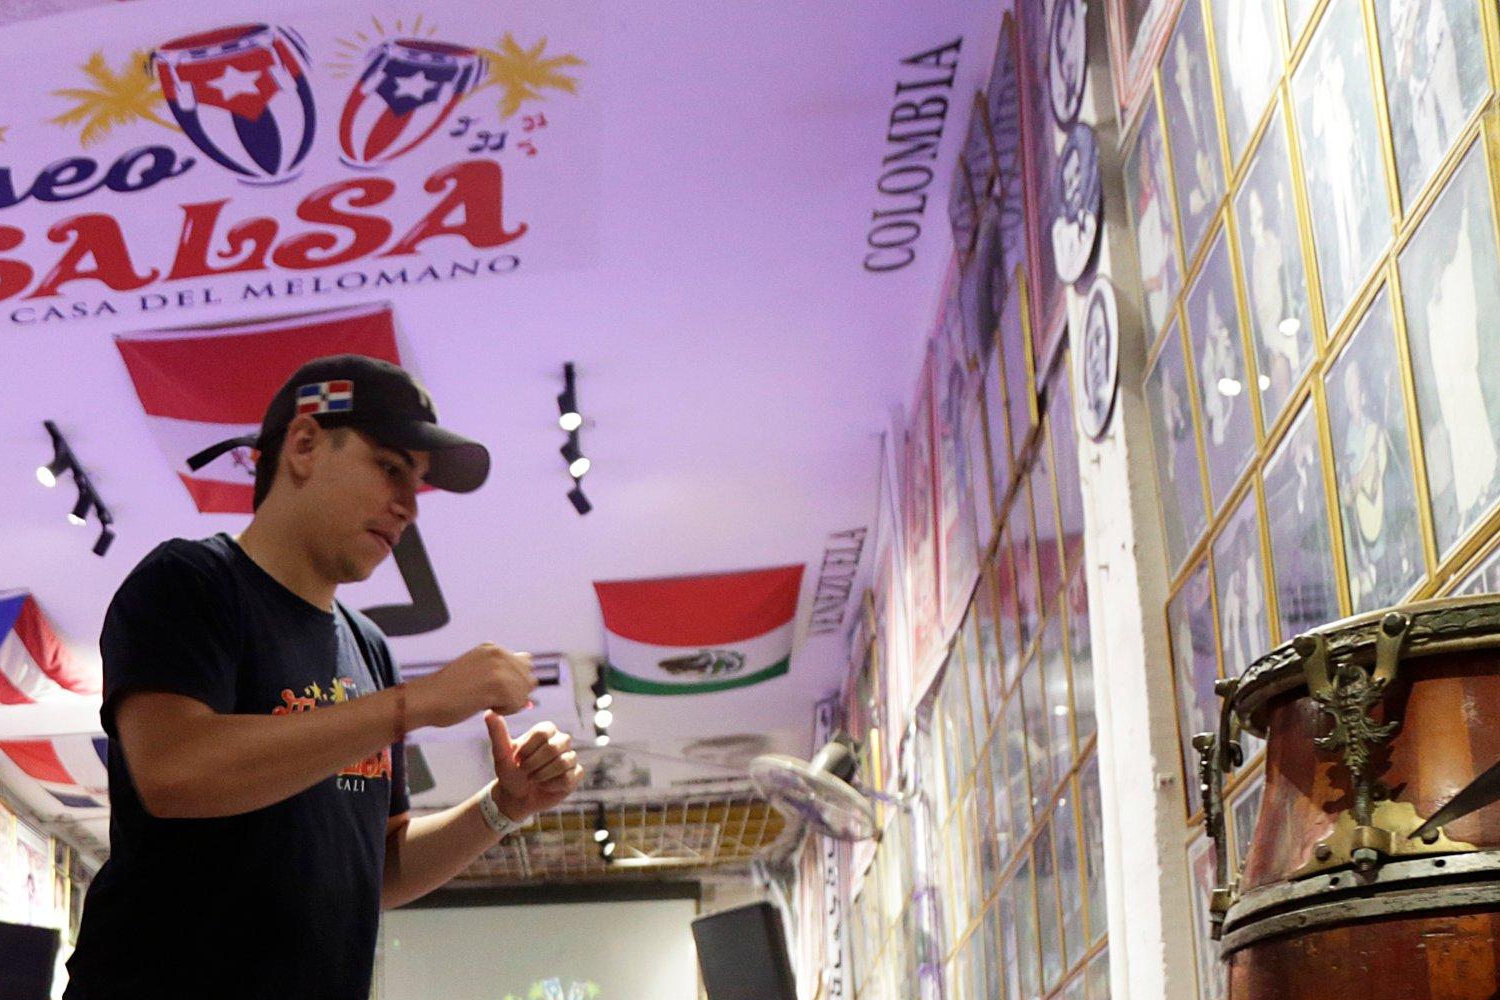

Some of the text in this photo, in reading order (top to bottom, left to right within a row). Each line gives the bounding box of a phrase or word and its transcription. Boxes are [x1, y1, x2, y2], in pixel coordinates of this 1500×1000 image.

[863, 36, 964, 273] COLOMBIA
[10, 299, 119, 326] CASA
[139, 287, 223, 312] DEL
[240, 254, 522, 302] MELOMANO
[336, 777, 366, 793] CALI
